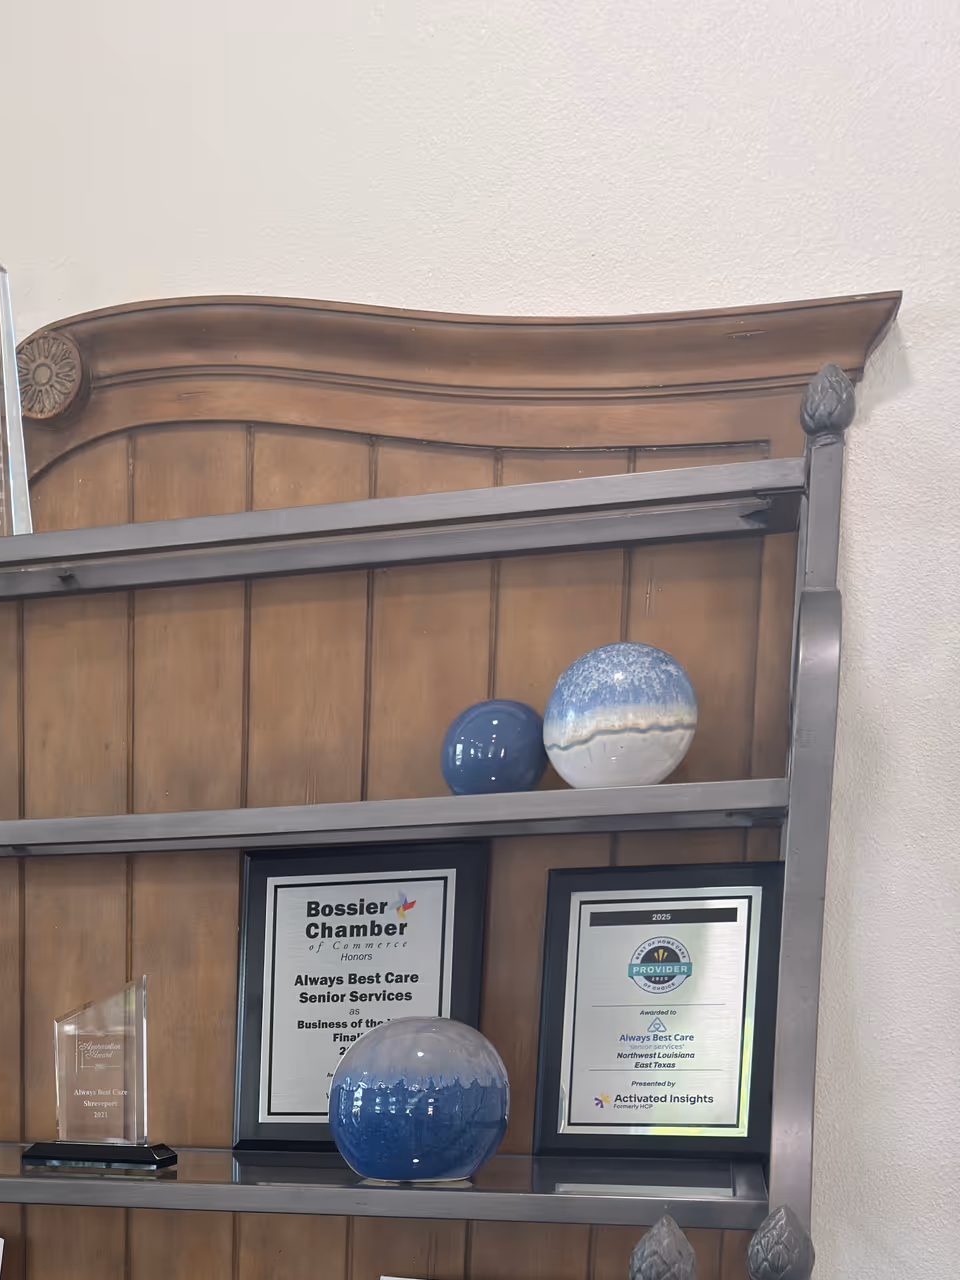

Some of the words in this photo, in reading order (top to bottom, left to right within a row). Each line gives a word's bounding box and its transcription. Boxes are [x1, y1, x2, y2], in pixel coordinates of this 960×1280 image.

[306, 898, 388, 918] Bossier
[652, 913, 671, 921] 2025
[305, 920, 408, 939] Chamber
[309, 941, 324, 953] of
[332, 940, 408, 951] Commerce
[340, 952, 373, 962] Honors
[632, 965, 688, 974] PROVIDER
[294, 973, 344, 987] Always
[347, 973, 381, 985] Best
[384, 972, 419, 983] Care
[299, 991, 346, 1003] Senior
[349, 990, 412, 1002] Services
[348, 1008, 360, 1016] as
[297, 1020, 348, 1029] Business
[350, 1019, 363, 1028] of
[619, 1034, 651, 1043] Always
[652, 1034, 672, 1042] Best
[674, 1033, 694, 1041] Care
[83, 1100, 118, 1108] Shreveport
[614, 1094, 667, 1103] Activated
[670, 1094, 714, 1105] Insights
